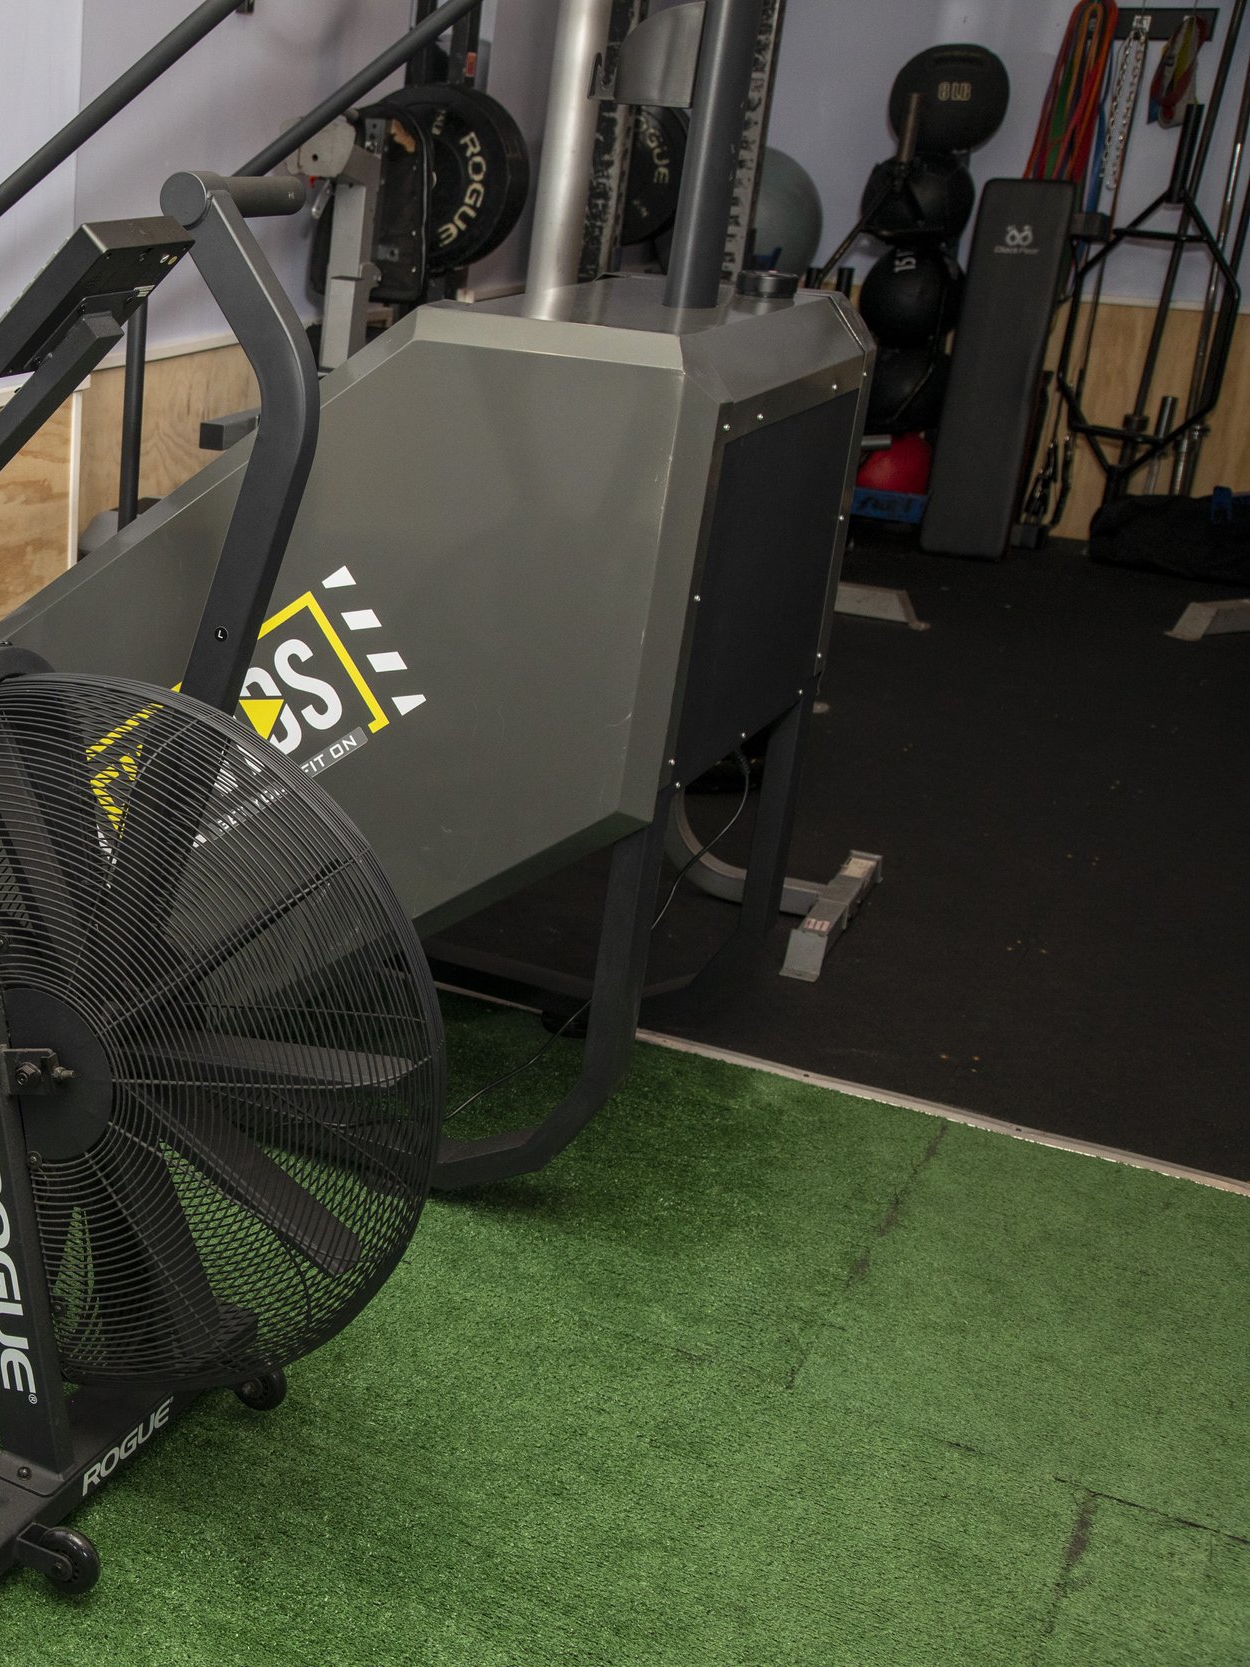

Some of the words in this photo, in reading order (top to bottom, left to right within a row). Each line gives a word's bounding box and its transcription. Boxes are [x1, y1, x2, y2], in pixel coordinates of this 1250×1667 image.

[438, 131, 486, 247] ROGUE
[329, 735, 357, 758] ON
[82, 1396, 174, 1496] ROGUE
